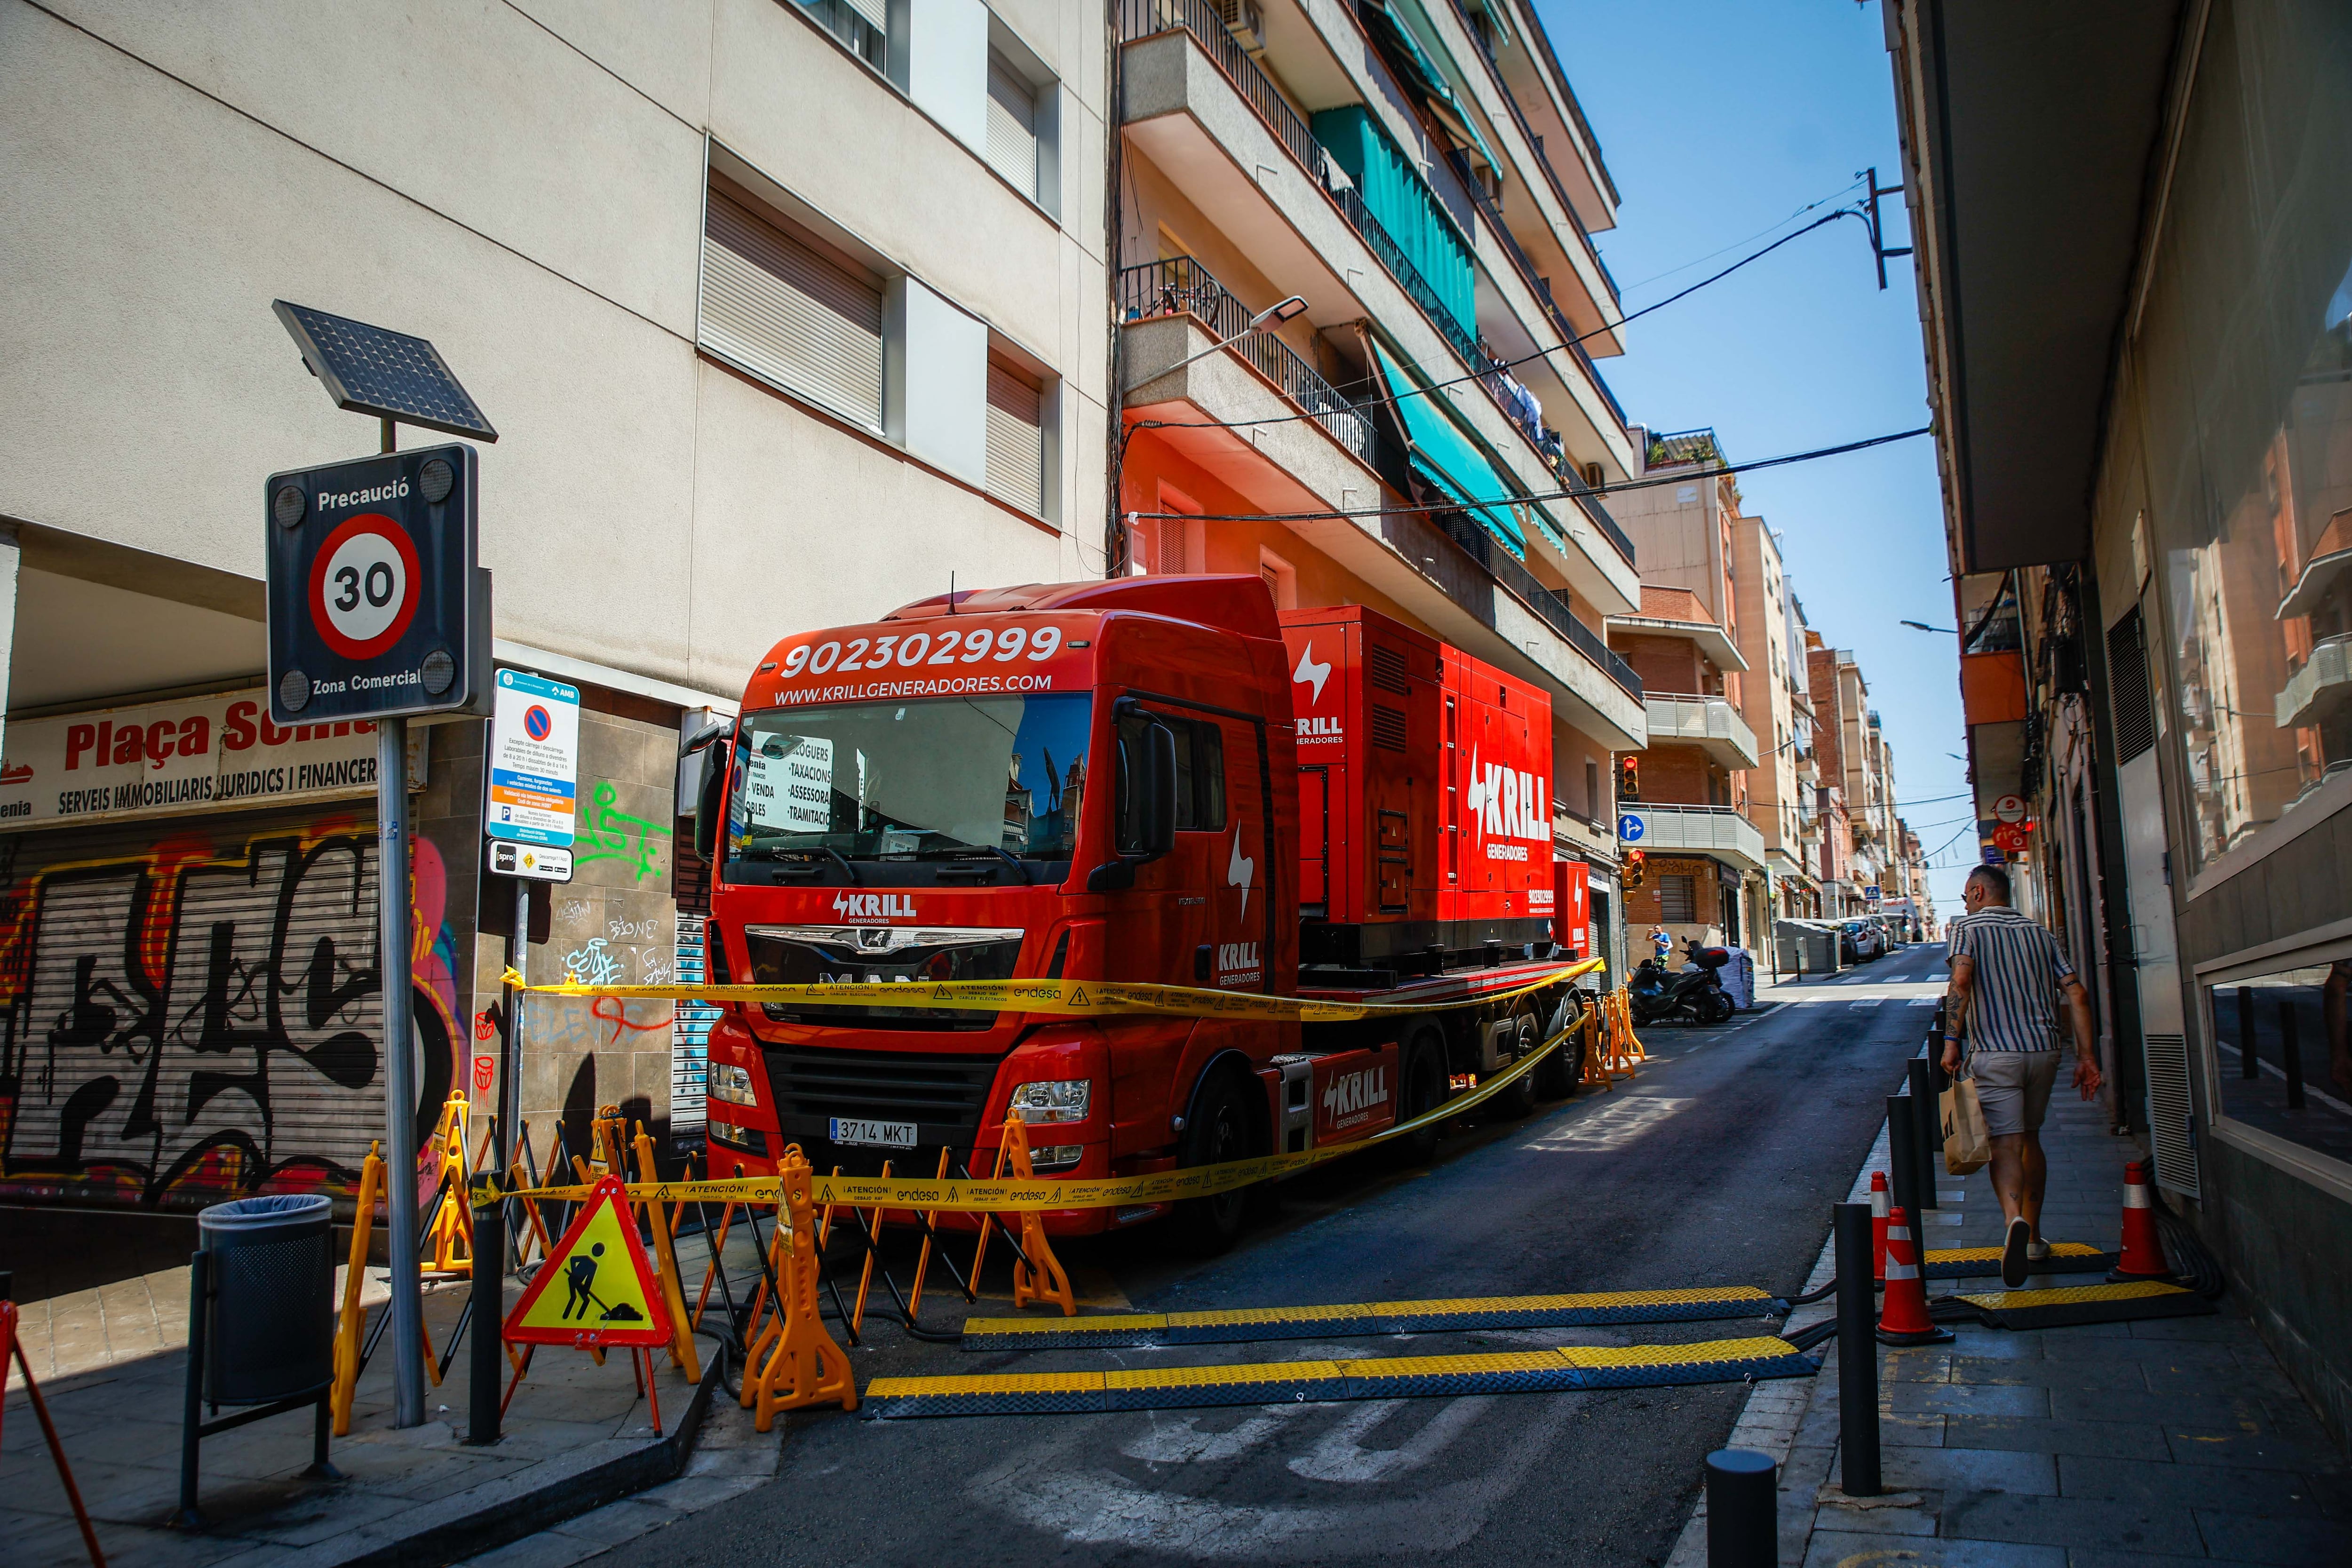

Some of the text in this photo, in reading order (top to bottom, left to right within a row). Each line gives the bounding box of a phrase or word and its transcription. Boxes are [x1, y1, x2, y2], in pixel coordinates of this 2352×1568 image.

[318, 477, 409, 511] Precaució
[334, 562, 394, 612] 30
[780, 626, 1061, 678] 902302999
[313, 669, 422, 695] Zona Comercial
[560, 689, 574, 699] AMB
[774, 675, 1052, 706] WWW.KRILLGENERADORES.COM
[1294, 717, 1343, 736] RILL
[65, 716, 210, 771] Plaça
[504, 744, 525, 754] Laborables
[543, 745, 564, 754] descàrrega
[59, 757, 378, 814] SERVEIS IMMOBILIARIS JURIDICS I FINANCER
[752, 782, 774, 798] VENDA
[1485, 762, 1550, 842] KRILL
[503, 809, 510, 819] P
[1487, 843, 1528, 862] GENERADORES
[1529, 889, 1554, 904] 902302999
[849, 894, 917, 917] KRILL
[1219, 942, 1259, 971] KRILL
[1220, 971, 1260, 986] GENERADORES
[880, 984, 926, 994] endesa
[1014, 987, 1061, 999] endesa
[1128, 991, 1152, 1001] endesa
[1337, 1065, 1387, 1115] KRILL
[1337, 1112, 1369, 1129] GENERADORES
[841, 1122, 877, 1140] 3714
[884, 1125, 913, 1143] MKT
[684, 1184, 748, 1193] ¡ATENCIÓN!
[1176, 1175, 1200, 1186] endesa
[897, 1188, 939, 1201] endesa
[1010, 1189, 1046, 1201] endesa
[1103, 1186, 1131, 1197] endesa
